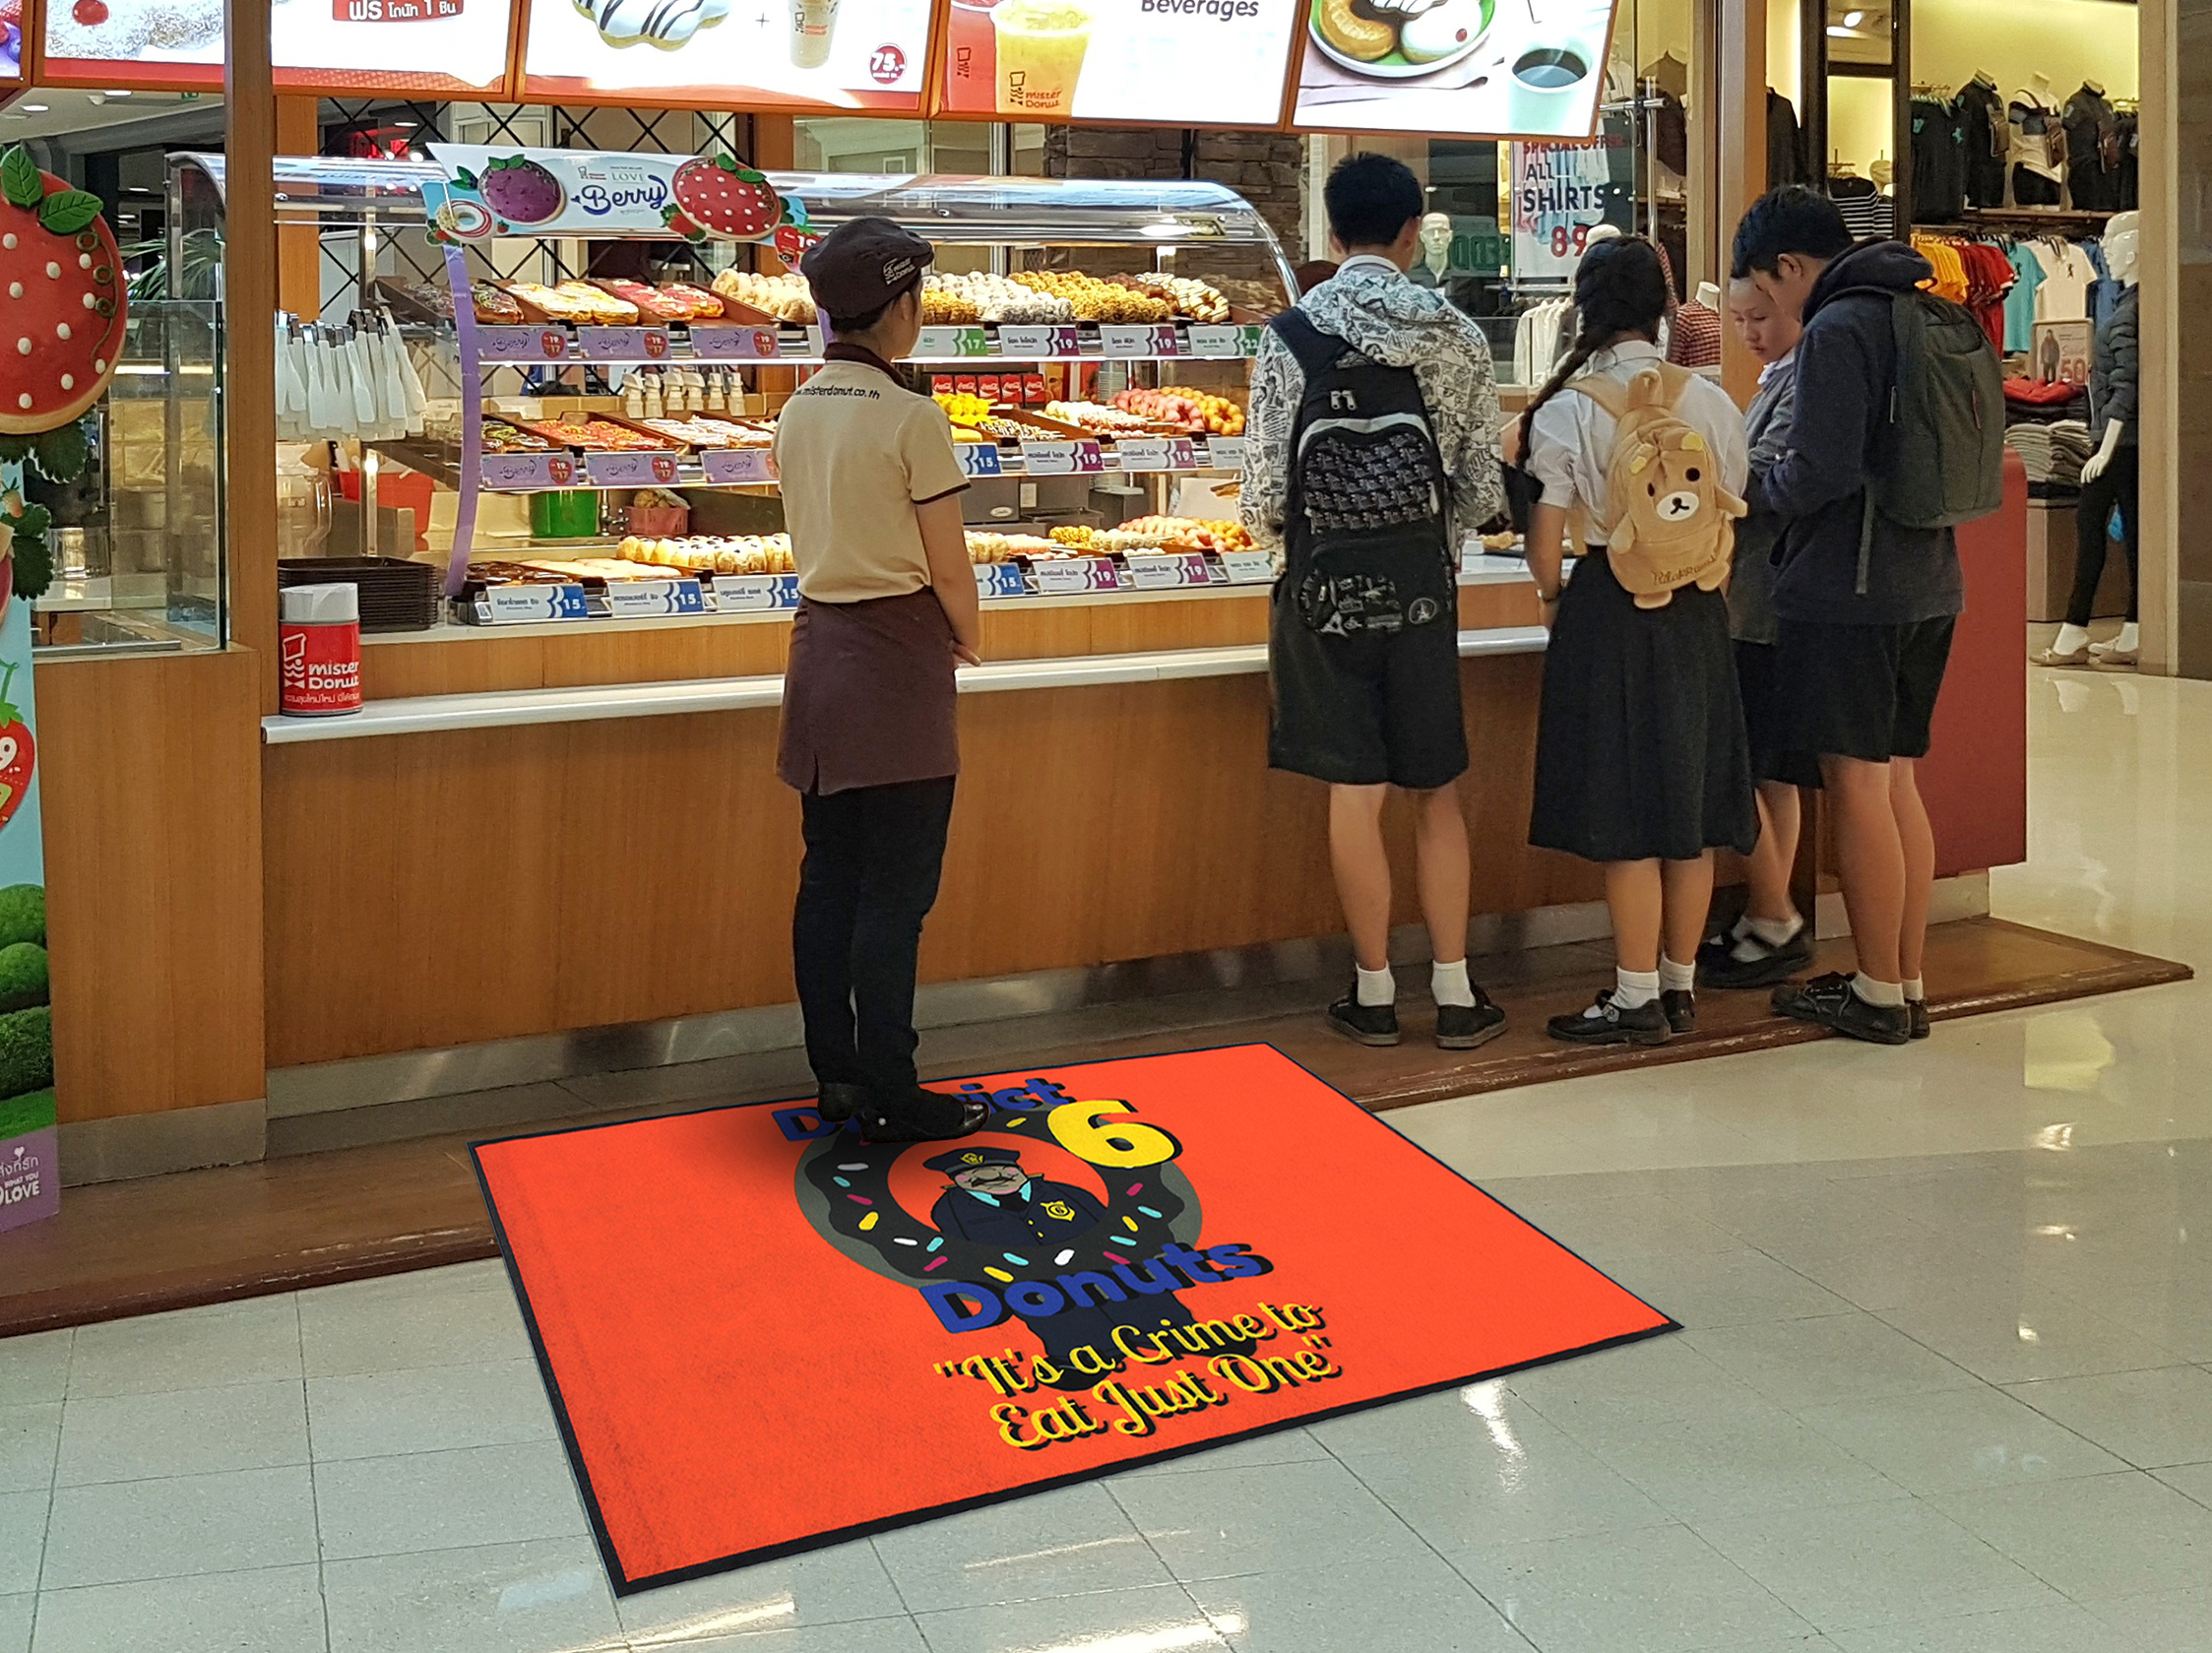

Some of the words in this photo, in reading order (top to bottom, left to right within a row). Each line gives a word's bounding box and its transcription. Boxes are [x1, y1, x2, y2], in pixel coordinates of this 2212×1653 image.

[348, 0, 383, 20] ฟร
[1141, 0, 1259, 22] Beverages
[1526, 162, 1555, 181] ALL
[581, 173, 668, 216] Berry
[1523, 184, 1606, 213] SHIRTS
[308, 660, 360, 675] mister
[308, 675, 359, 690] Donut
[772, 1078, 1071, 1141] Dict
[1046, 1099, 1177, 1169] 6
[5, 1180, 40, 1205] LOVE
[919, 1243, 1267, 1334] Donuts
[1069, 1344, 1118, 1375] a
[1110, 1317, 1268, 1365] Crime
[1257, 1302, 1323, 1333] to
[989, 1395, 1100, 1448] Eat
[1092, 1368, 1221, 1435] Just
[1207, 1334, 1337, 1393] One"
